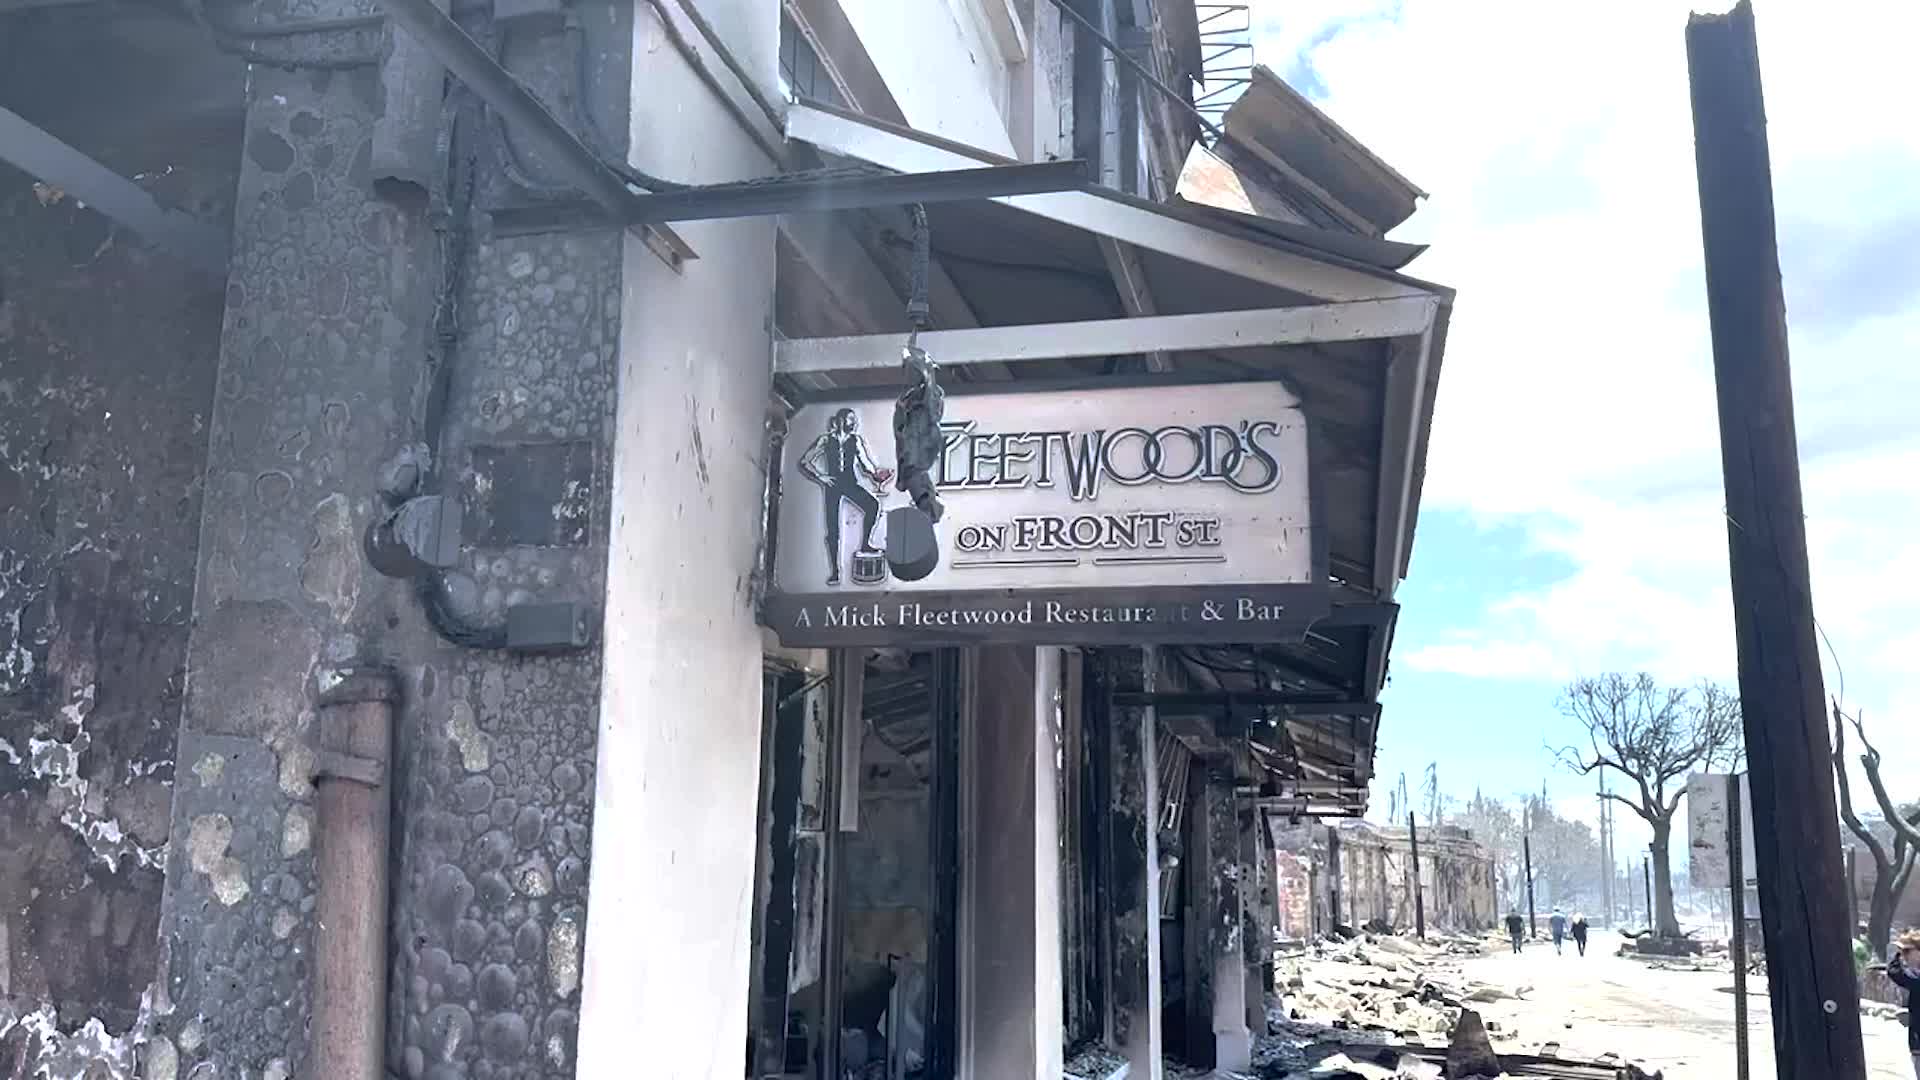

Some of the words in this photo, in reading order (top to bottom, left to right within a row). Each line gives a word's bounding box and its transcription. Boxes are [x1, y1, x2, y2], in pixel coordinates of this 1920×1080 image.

[957, 525, 1006, 550] ON
[1014, 512, 1174, 549] FRONT
[1178, 518, 1221, 546] ST.
[795, 607, 812, 628] A
[824, 604, 887, 627] Mick
[898, 600, 1032, 626] Fleetwood
[1200, 599, 1225, 622] &
[1237, 597, 1284, 622] Bar
